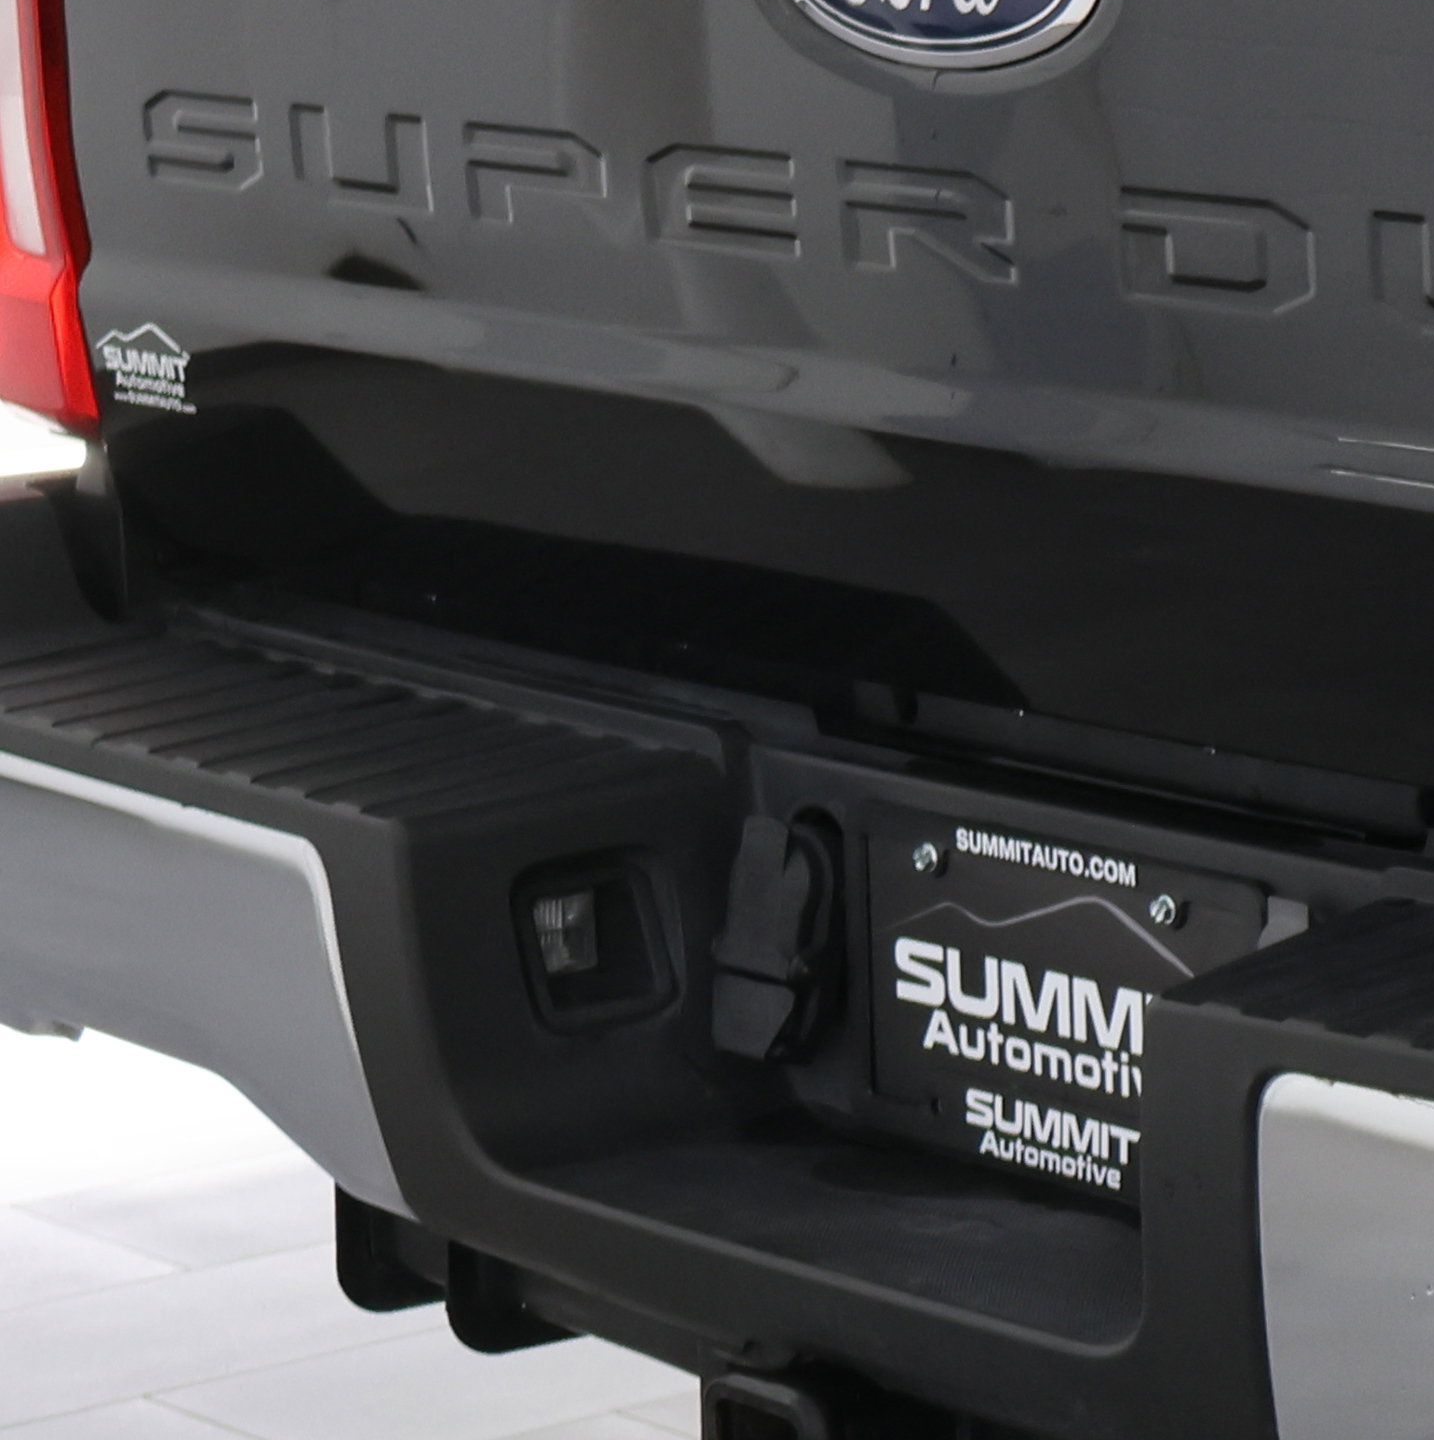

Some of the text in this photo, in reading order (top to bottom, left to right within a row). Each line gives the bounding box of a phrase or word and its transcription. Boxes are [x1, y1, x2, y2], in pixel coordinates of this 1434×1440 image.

[142, 88, 1017, 285] SUPER
[103, 345, 187, 383] SUMMIT
[955, 827, 1137, 888] SUMMITAUTO.COM
[894, 936, 1153, 1057] SUMM
[965, 1088, 1141, 1165] SUMMIT
[979, 1128, 1122, 1190] Automotive
